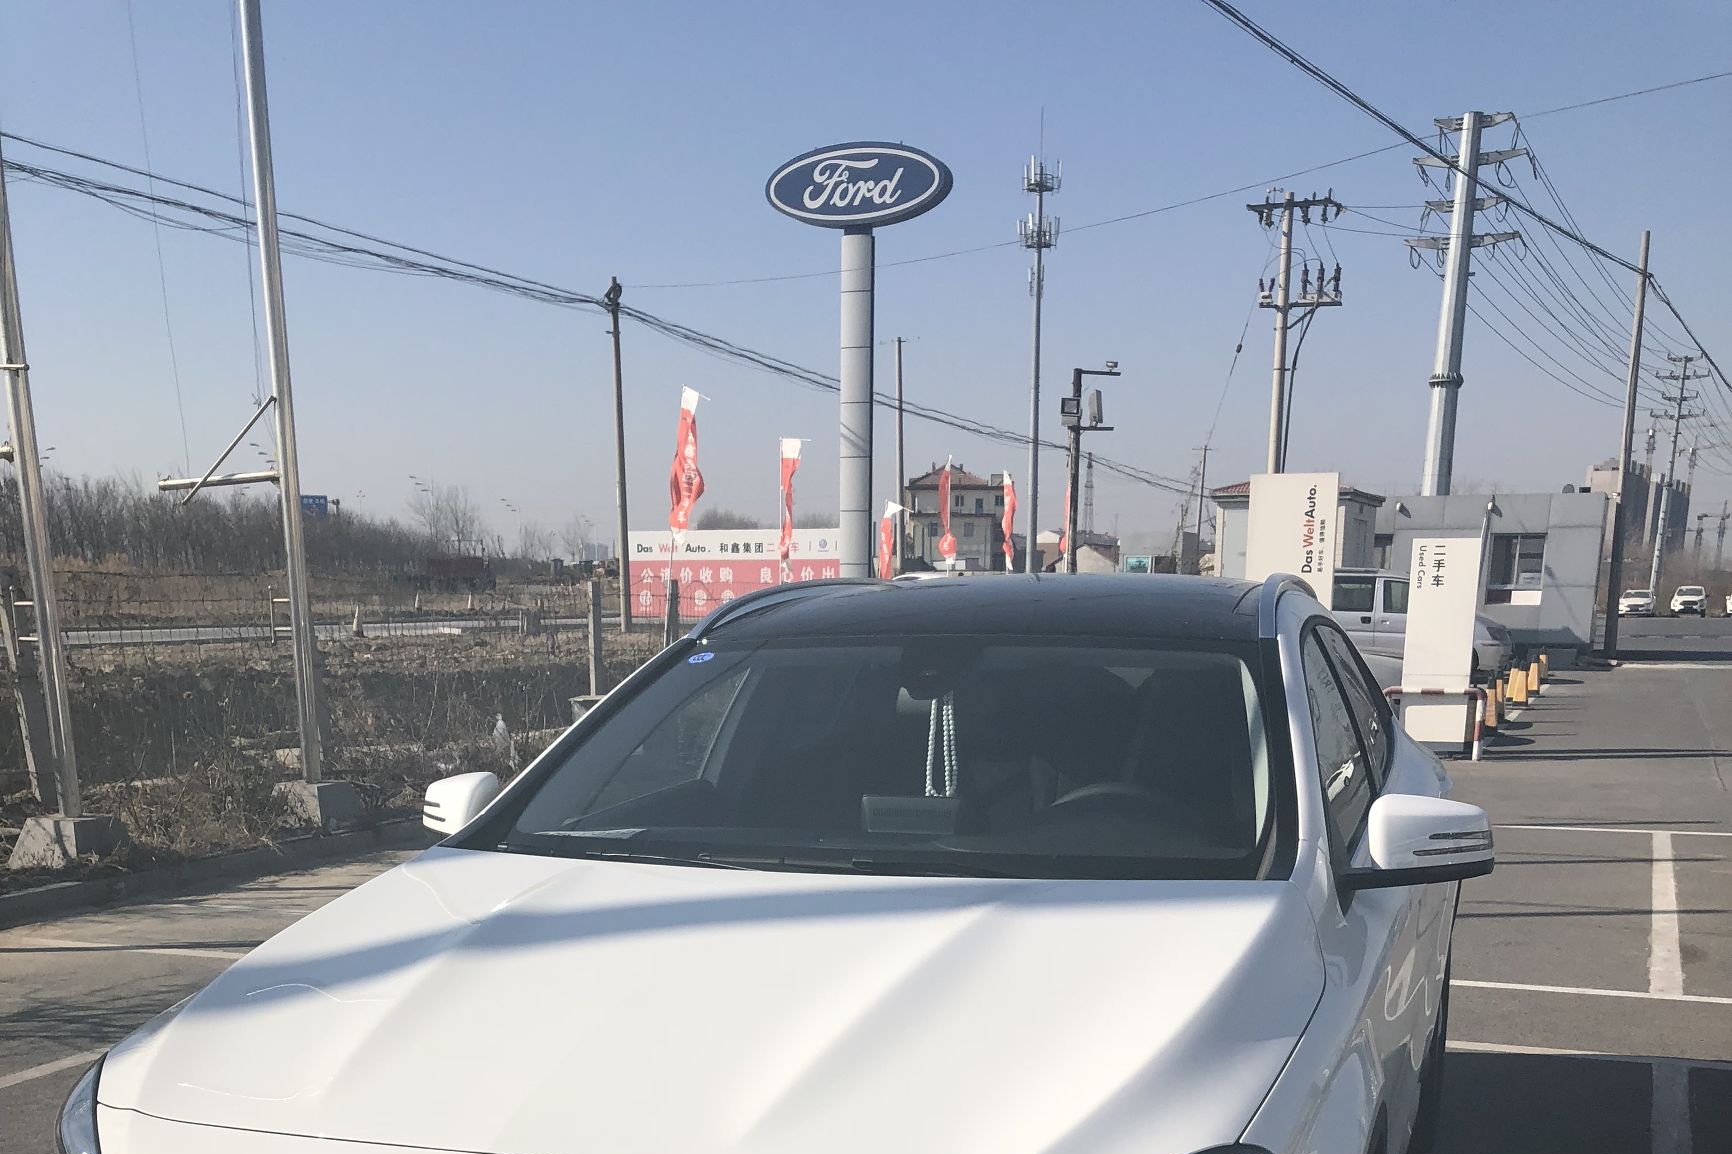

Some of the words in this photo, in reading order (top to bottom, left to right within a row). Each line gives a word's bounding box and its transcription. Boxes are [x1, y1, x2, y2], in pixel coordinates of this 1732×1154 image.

[803, 158, 904, 209] Ford
[637, 543, 653, 553] Das
[1418, 545, 1427, 567] Used
[1301, 549, 1313, 573] Das
[1431, 545, 1446, 587] 二手车
[1416, 570, 1426, 589] Cars
